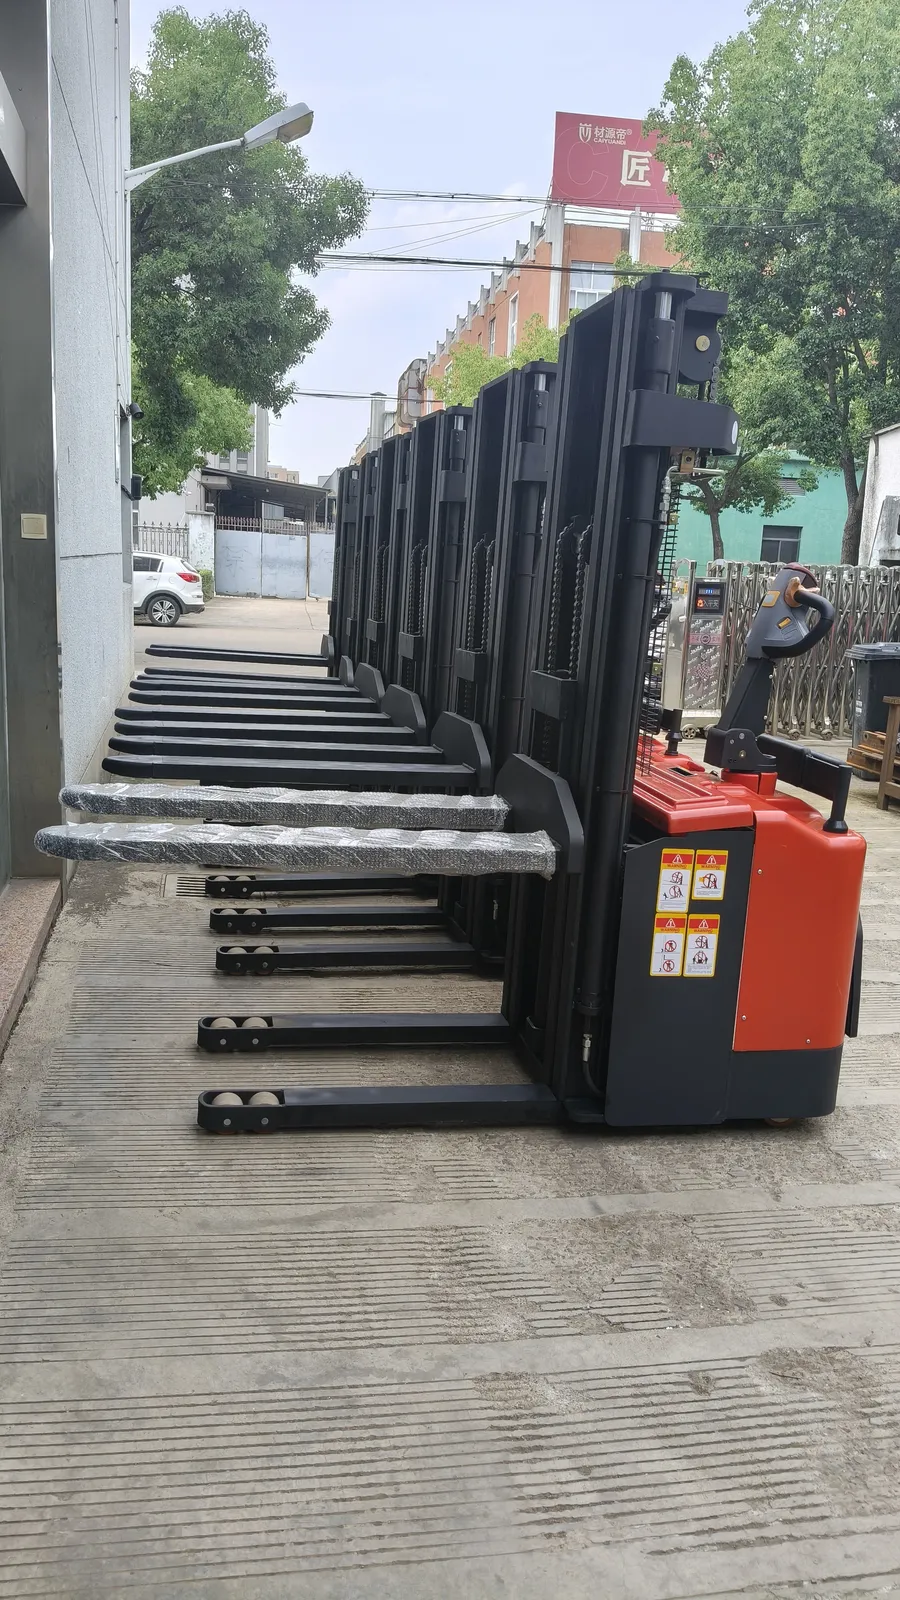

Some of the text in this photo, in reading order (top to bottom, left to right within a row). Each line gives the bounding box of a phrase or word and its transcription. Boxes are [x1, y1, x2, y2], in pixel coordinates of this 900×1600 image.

[594, 126, 626, 139] 材源帝
[620, 149, 652, 186] 匠
